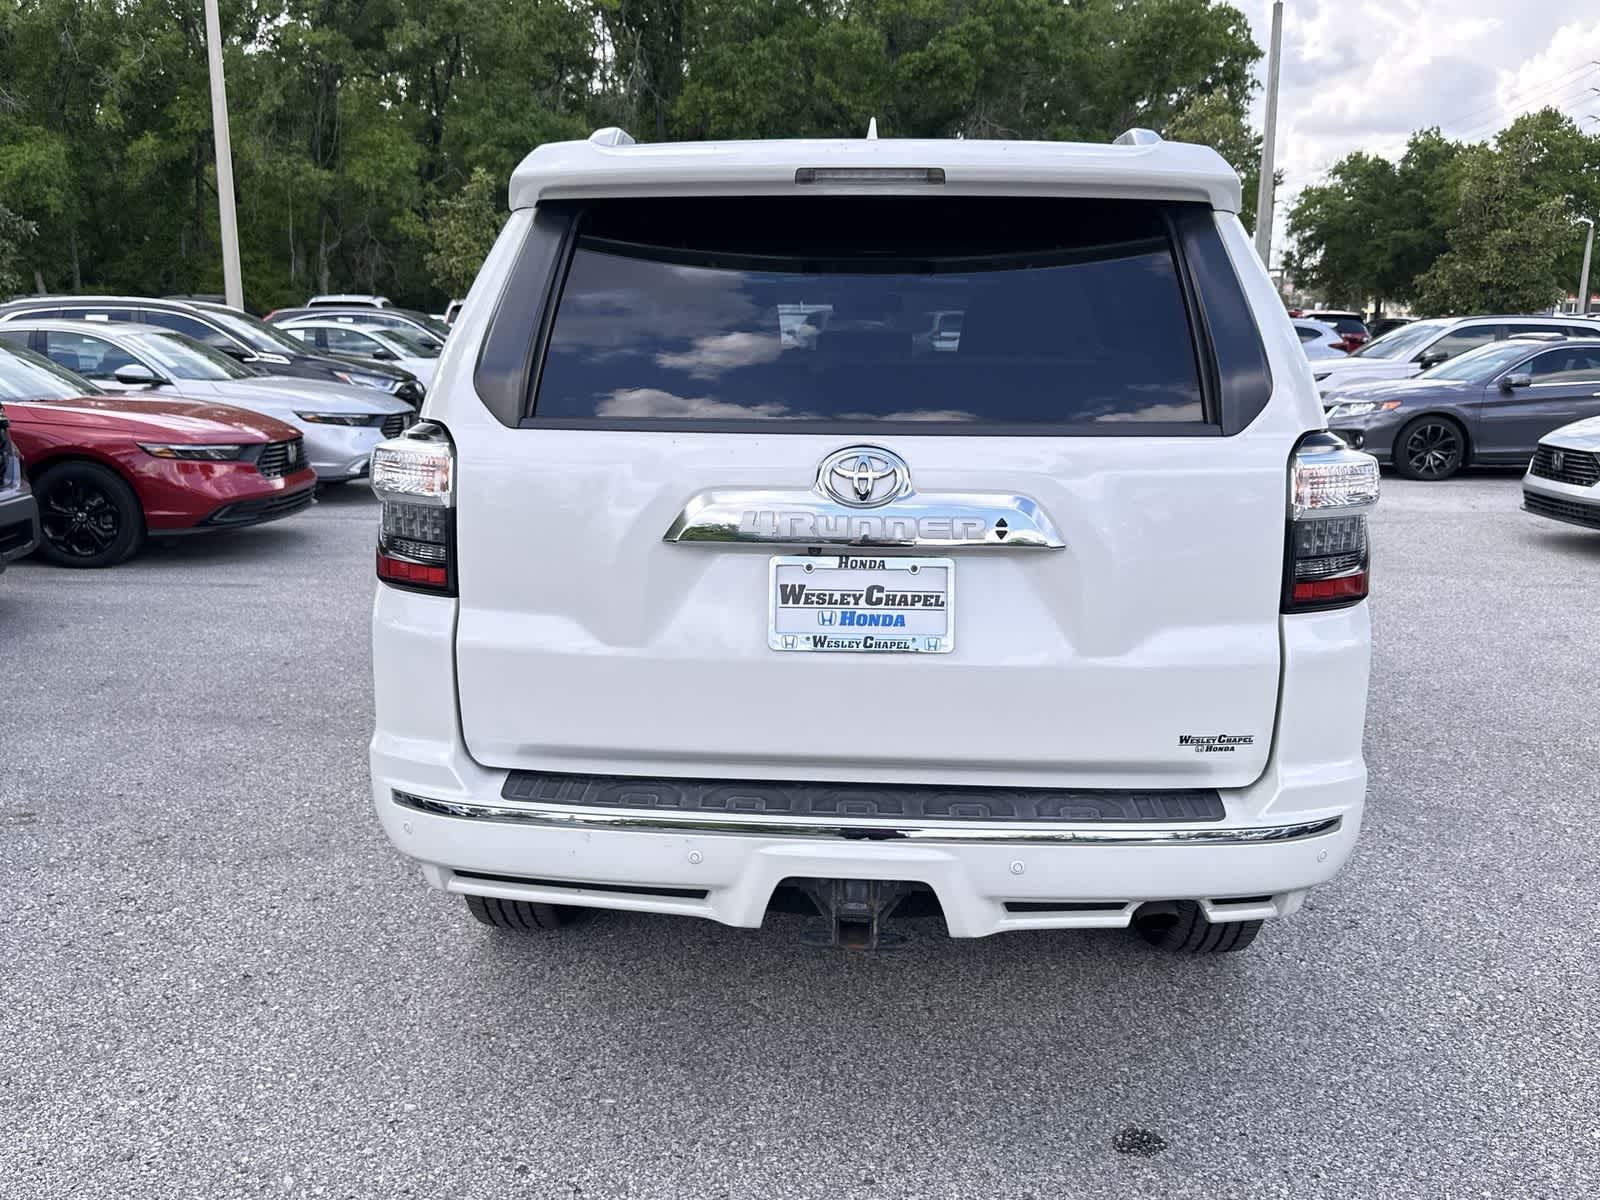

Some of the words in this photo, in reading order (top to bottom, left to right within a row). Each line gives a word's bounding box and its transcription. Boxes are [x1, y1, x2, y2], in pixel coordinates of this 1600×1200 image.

[838, 556, 887, 569] HONDA
[779, 583, 864, 607] WESLEY
[865, 584, 945, 608] CHAPEL
[839, 611, 906, 627] HONDA
[812, 635, 862, 649] WESLEY
[862, 636, 910, 650] CHAPEL
[1179, 735, 1217, 744] WESLEY
[1217, 734, 1254, 744] CHAPEL
